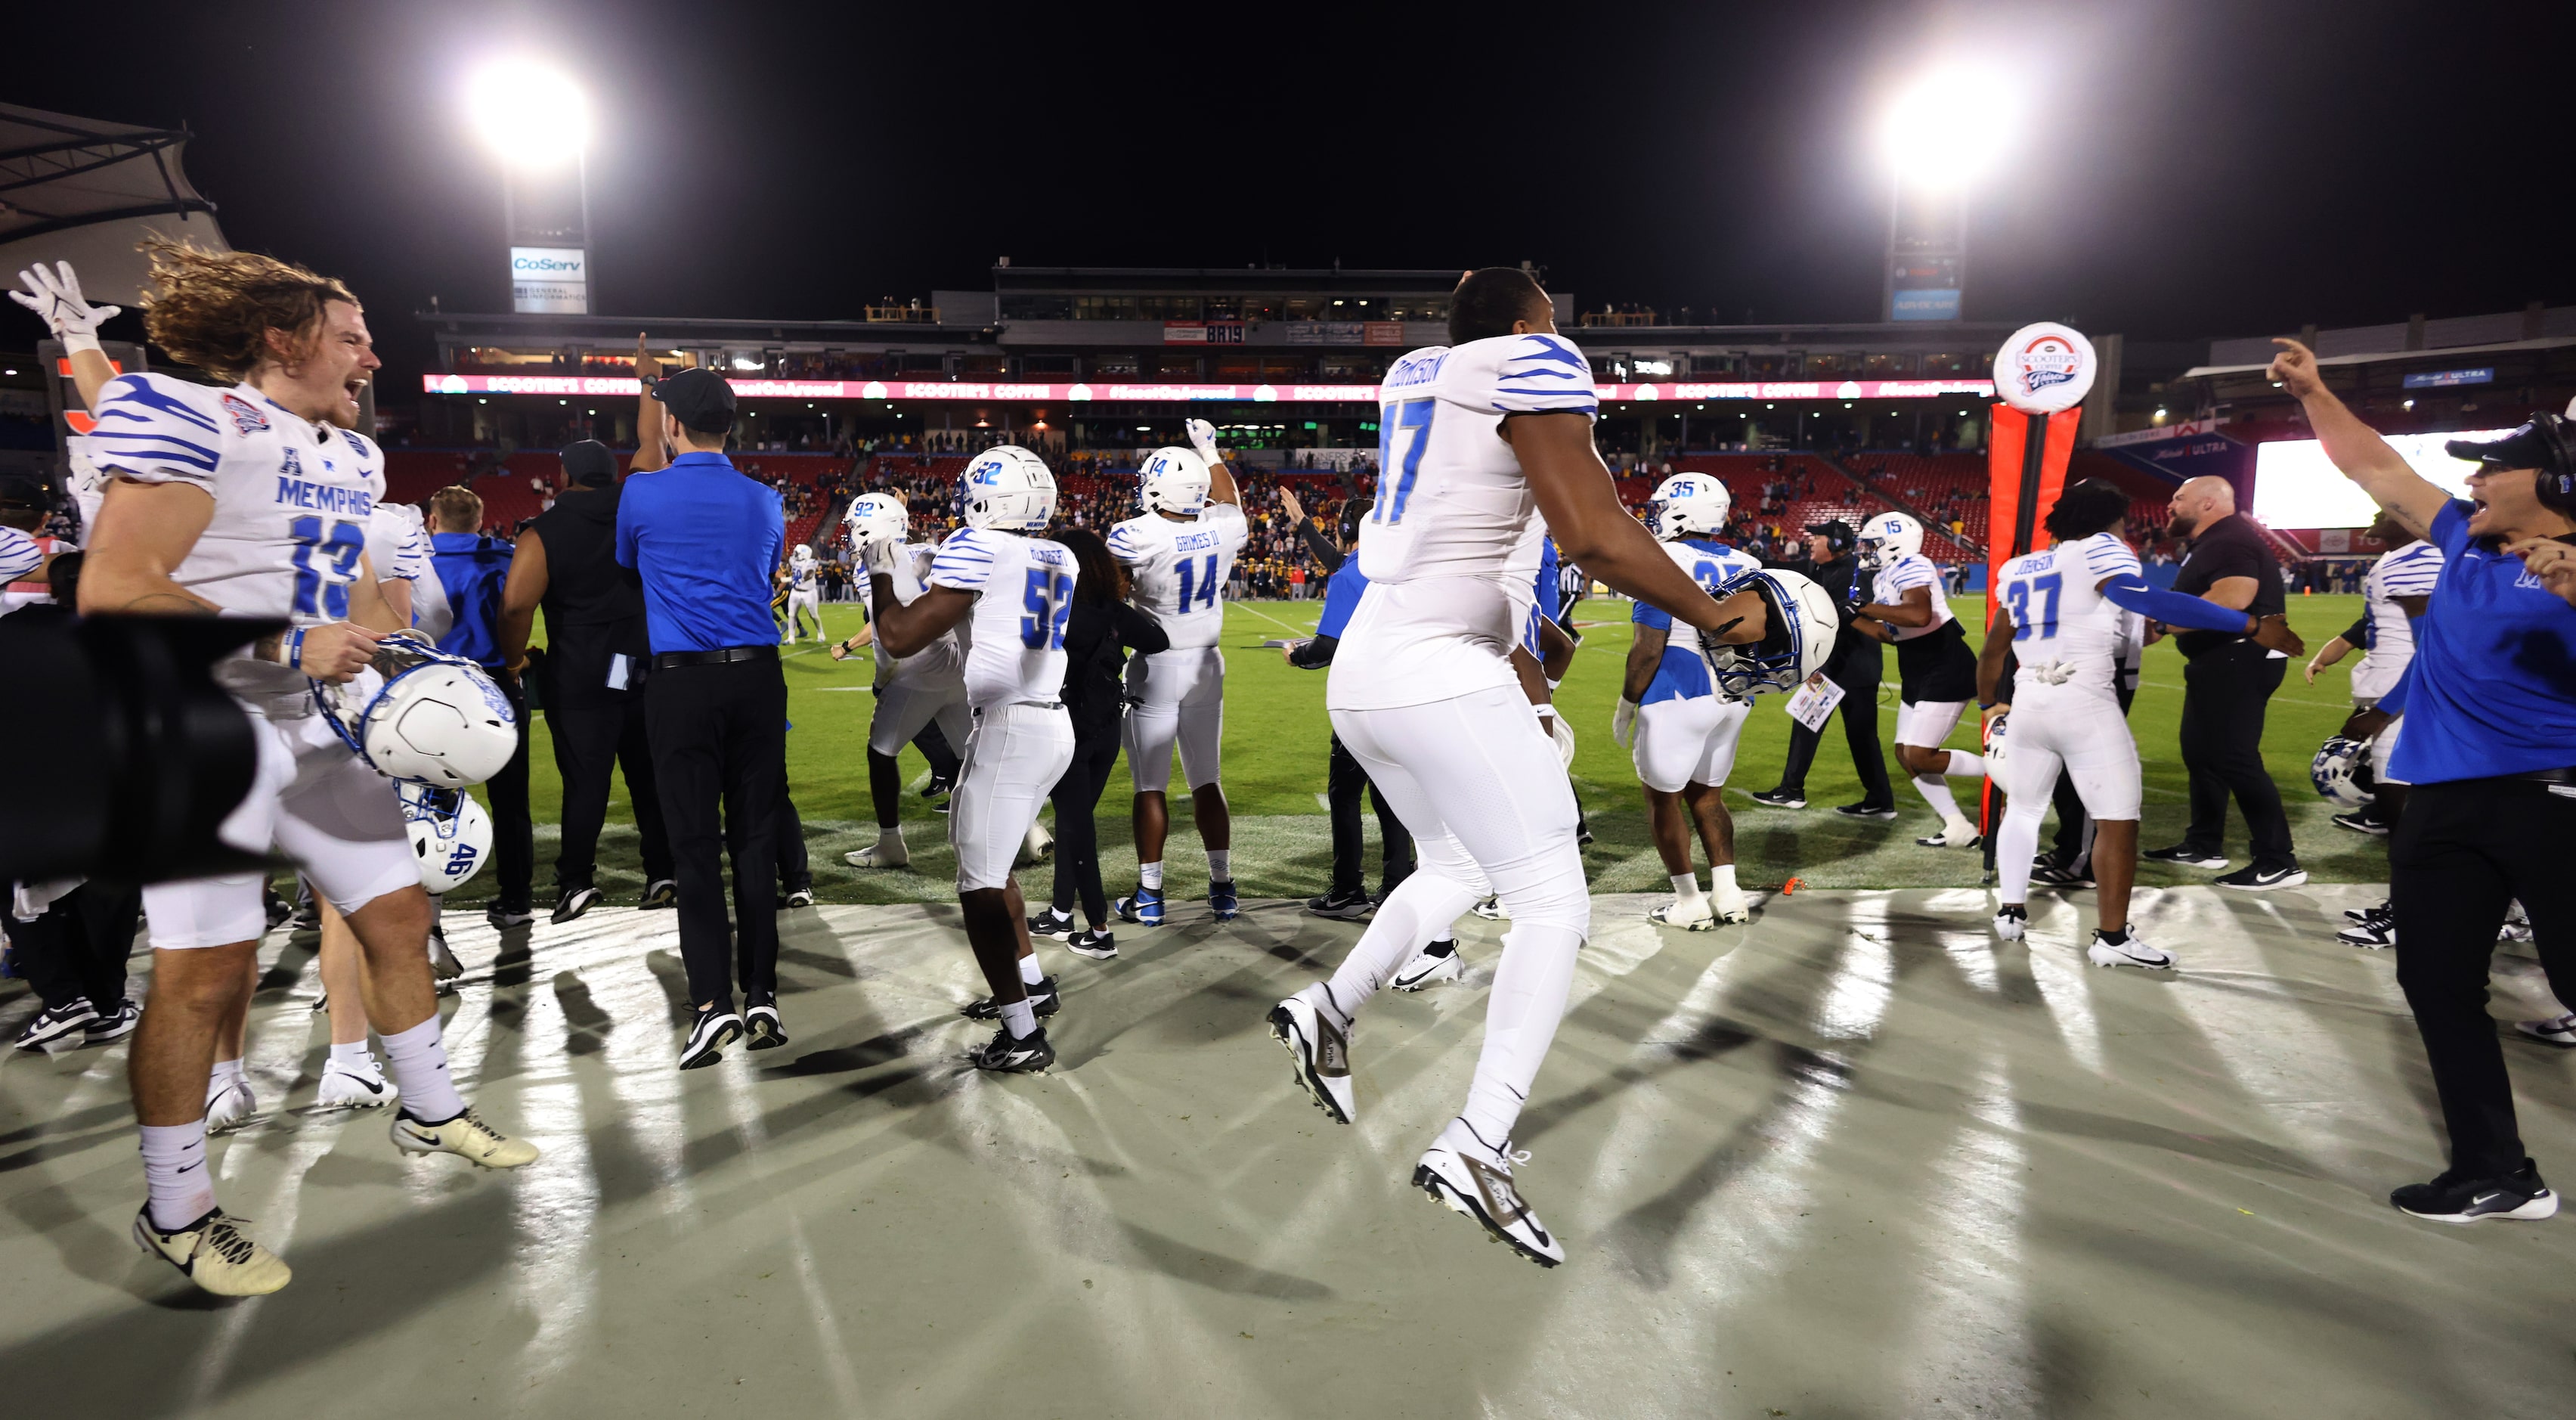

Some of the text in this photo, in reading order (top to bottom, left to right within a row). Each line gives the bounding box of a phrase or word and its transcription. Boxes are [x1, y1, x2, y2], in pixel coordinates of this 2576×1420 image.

[514, 258, 581, 271] CoServ
[1206, 325, 1243, 343] BR19
[2022, 355, 2077, 364] SCOOTER'S
[487, 377, 579, 393] SCOOTER'S
[905, 383, 1050, 399] SCOOTER'S COFFEE
[1293, 386, 1375, 401] SCOOTER'S
[1675, 384, 1758, 399] SCOOTER'S
[2193, 442, 2228, 456] ULTRA
[1149, 457, 1168, 477] 14
[1372, 396, 1436, 527] 17
[973, 461, 1003, 486] 52
[275, 476, 372, 516] MEMPHIS
[1669, 482, 1695, 498] 35
[854, 502, 875, 517] 92
[1883, 520, 1903, 535] 15
[1176, 532, 1210, 553] GRIMES
[289, 514, 364, 621] 13
[2014, 553, 2056, 575] JOHNSON
[1174, 553, 1218, 615] 14
[1020, 567, 1075, 651] 52
[2007, 572, 2062, 642] 37
[444, 843, 478, 876] 46
